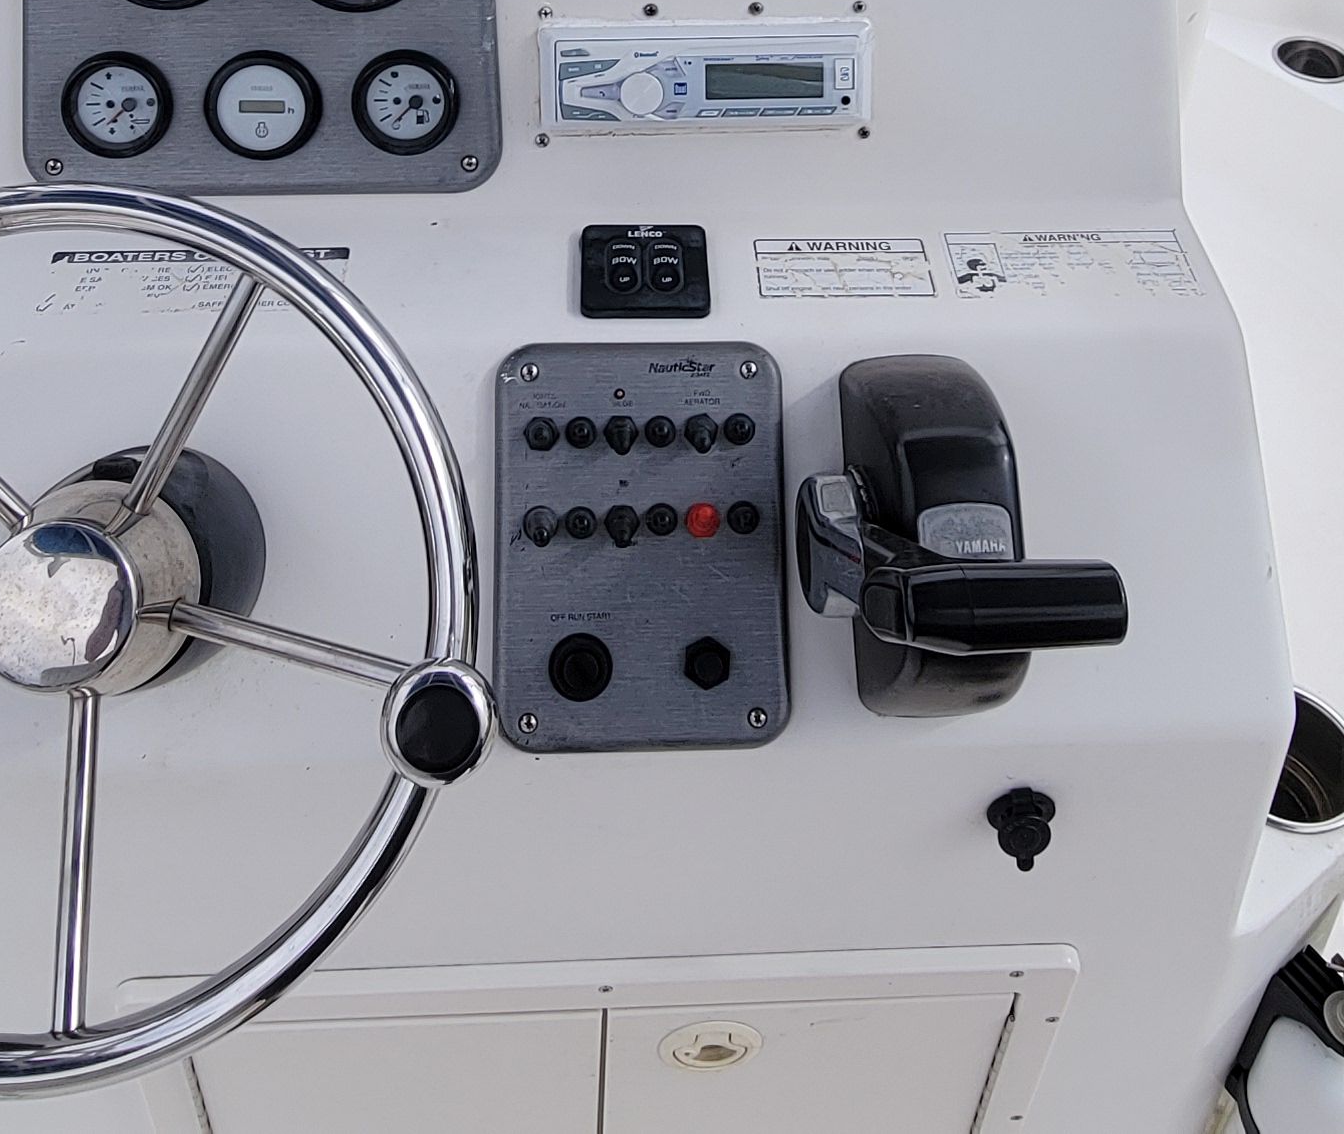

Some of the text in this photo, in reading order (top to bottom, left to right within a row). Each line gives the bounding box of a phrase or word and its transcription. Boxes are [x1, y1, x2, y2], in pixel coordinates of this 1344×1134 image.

[627, 230, 663, 238] LENCO
[1034, 233, 1101, 241] WARNNG
[807, 241, 891, 251] WARNING
[73, 251, 187, 262] BOATERS
[611, 256, 637, 265] BOW
[653, 256, 679, 265] BOW
[648, 361, 716, 374] NauticStar
[956, 539, 1006, 554] YAMAHA
